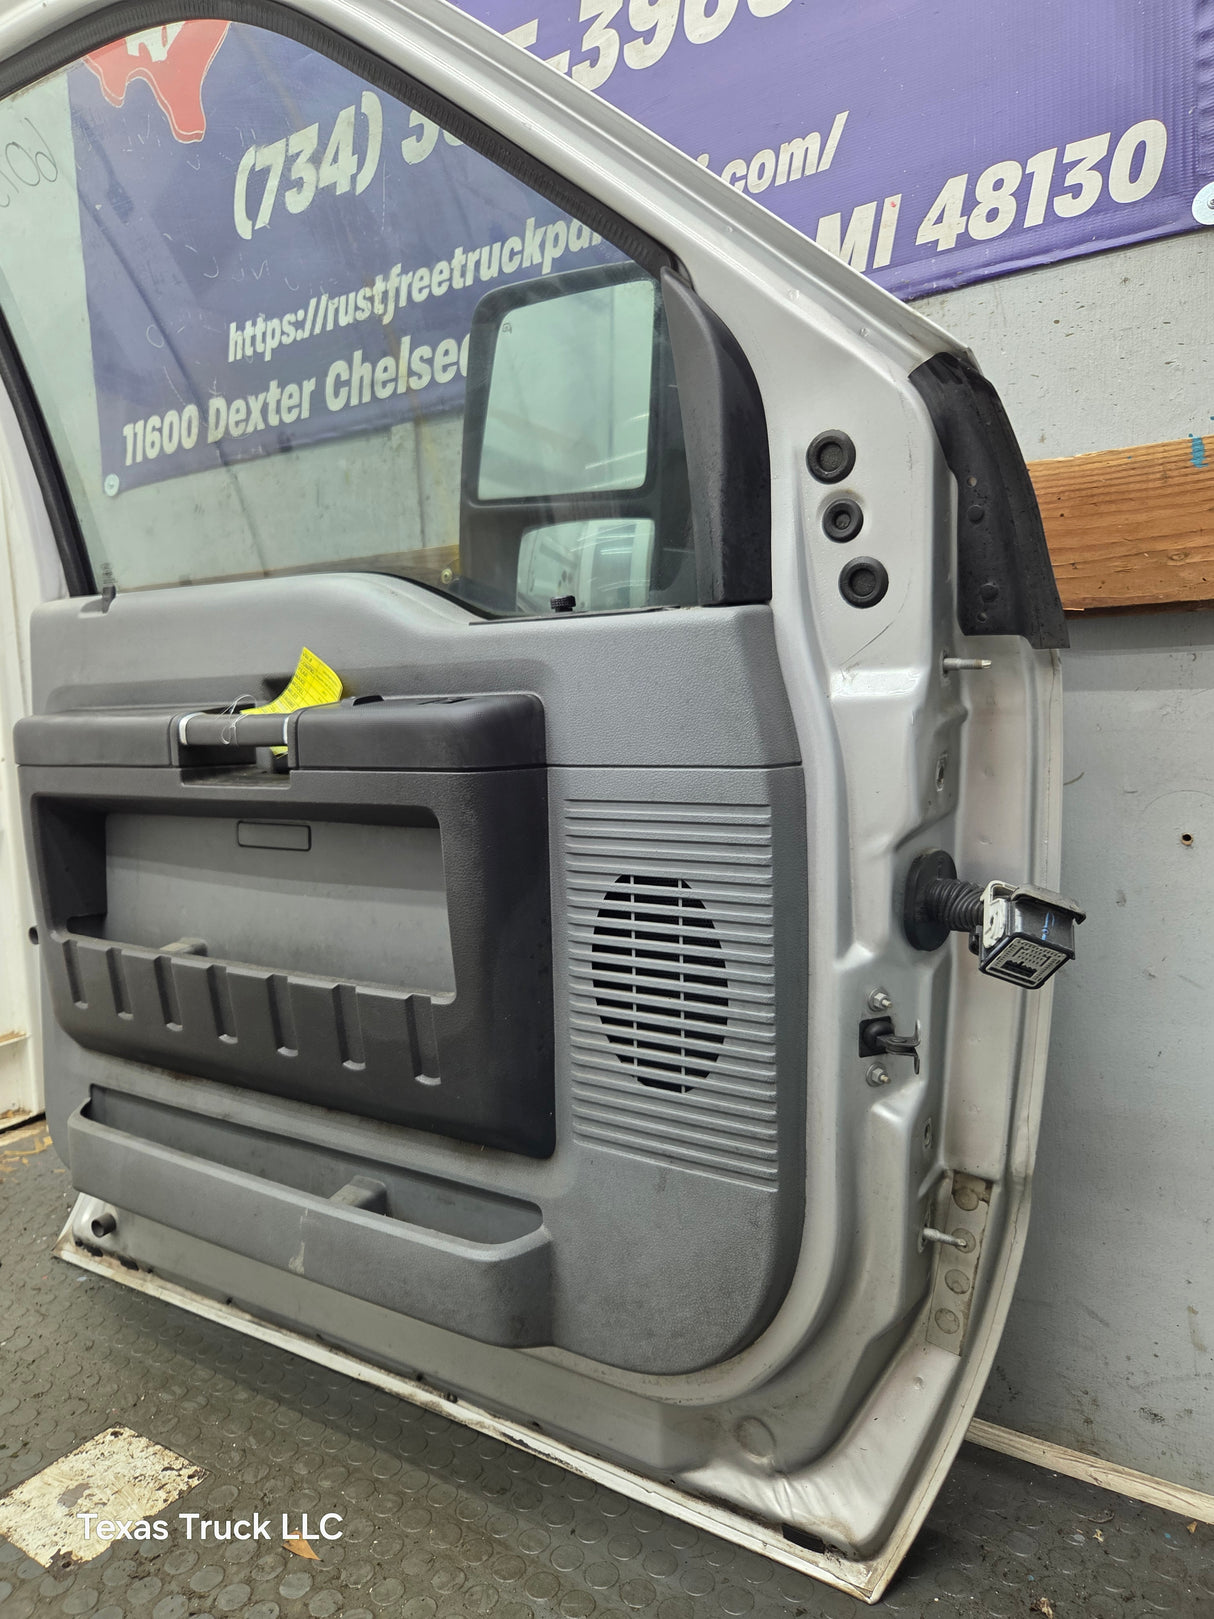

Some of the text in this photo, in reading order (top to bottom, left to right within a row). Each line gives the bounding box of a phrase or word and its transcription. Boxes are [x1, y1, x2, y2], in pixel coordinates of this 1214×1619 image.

[233, 90, 383, 240] (734)
[122, 119, 1168, 466] 11600 Dexter Chelse MI 48130
[228, 217, 601, 363] https://rustfreetruckpa
